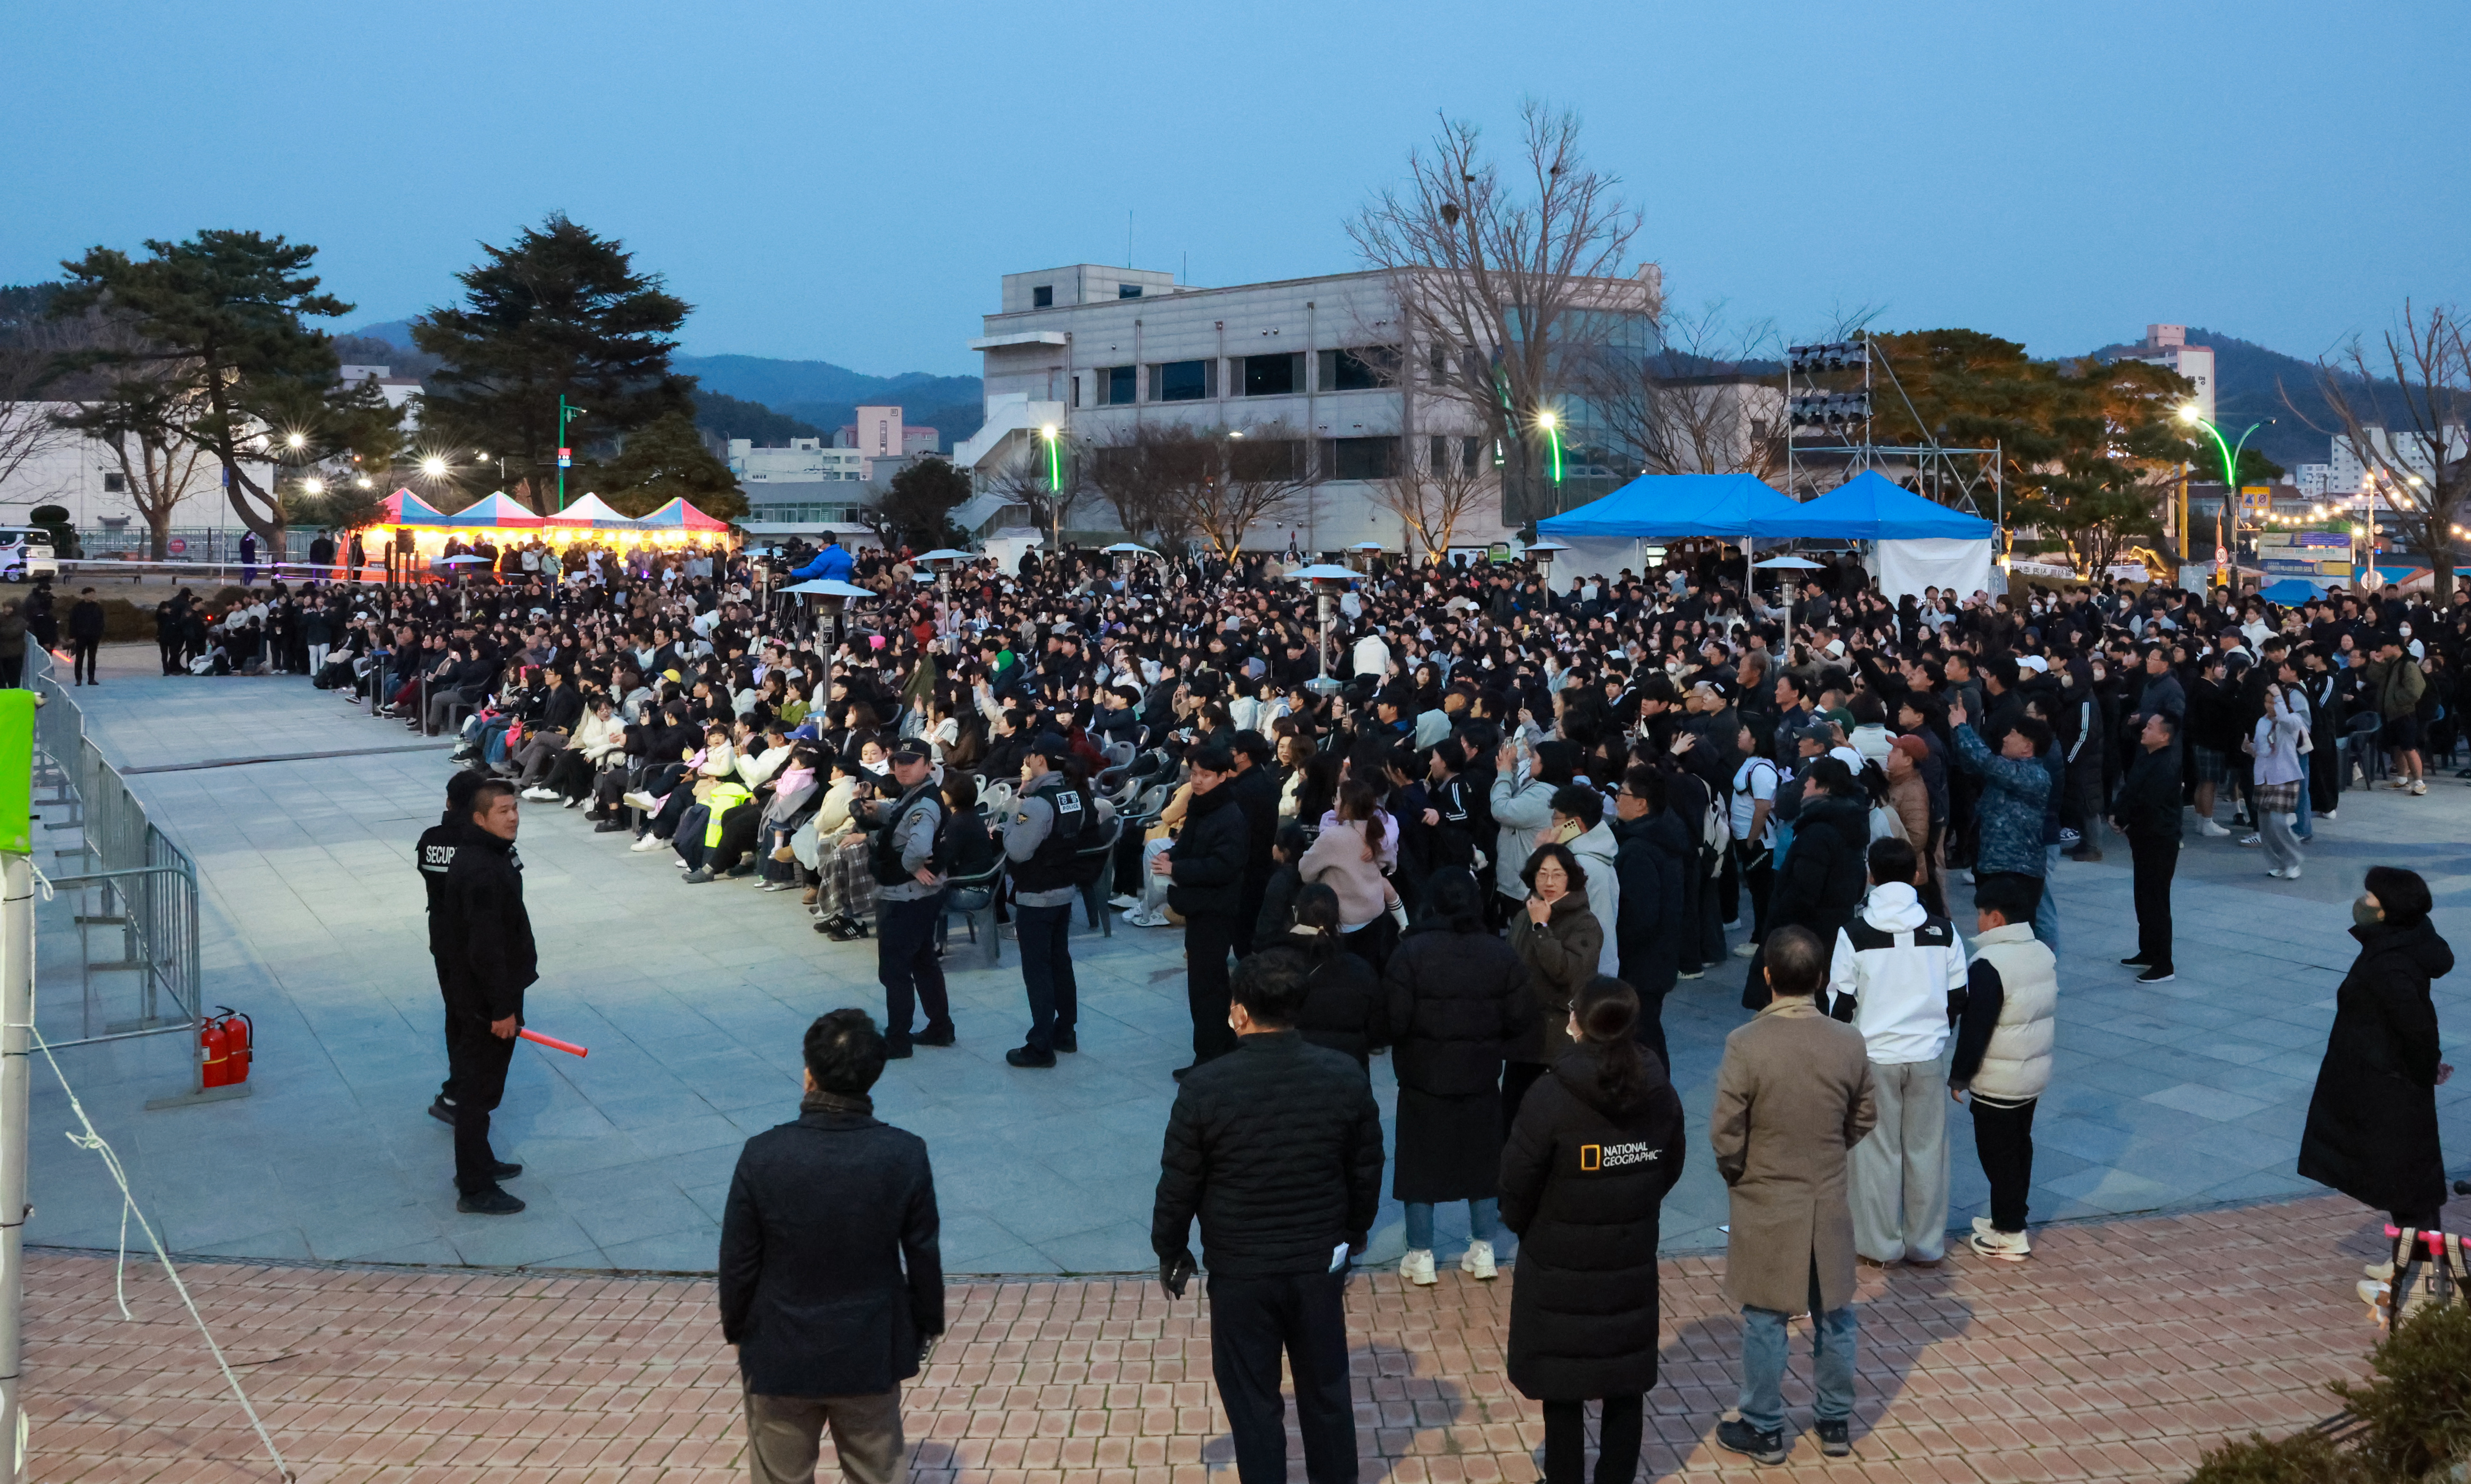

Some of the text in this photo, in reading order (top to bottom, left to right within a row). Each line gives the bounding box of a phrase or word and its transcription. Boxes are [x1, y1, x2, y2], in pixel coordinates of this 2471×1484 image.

[2218, 551, 2225, 560] 30
[1060, 793, 1077, 805] 경찰
[426, 845, 457, 864] SECUR
[1604, 1141, 1648, 1157] NATIONAL
[1603, 1150, 1658, 1167] GEOGRAPHIC
